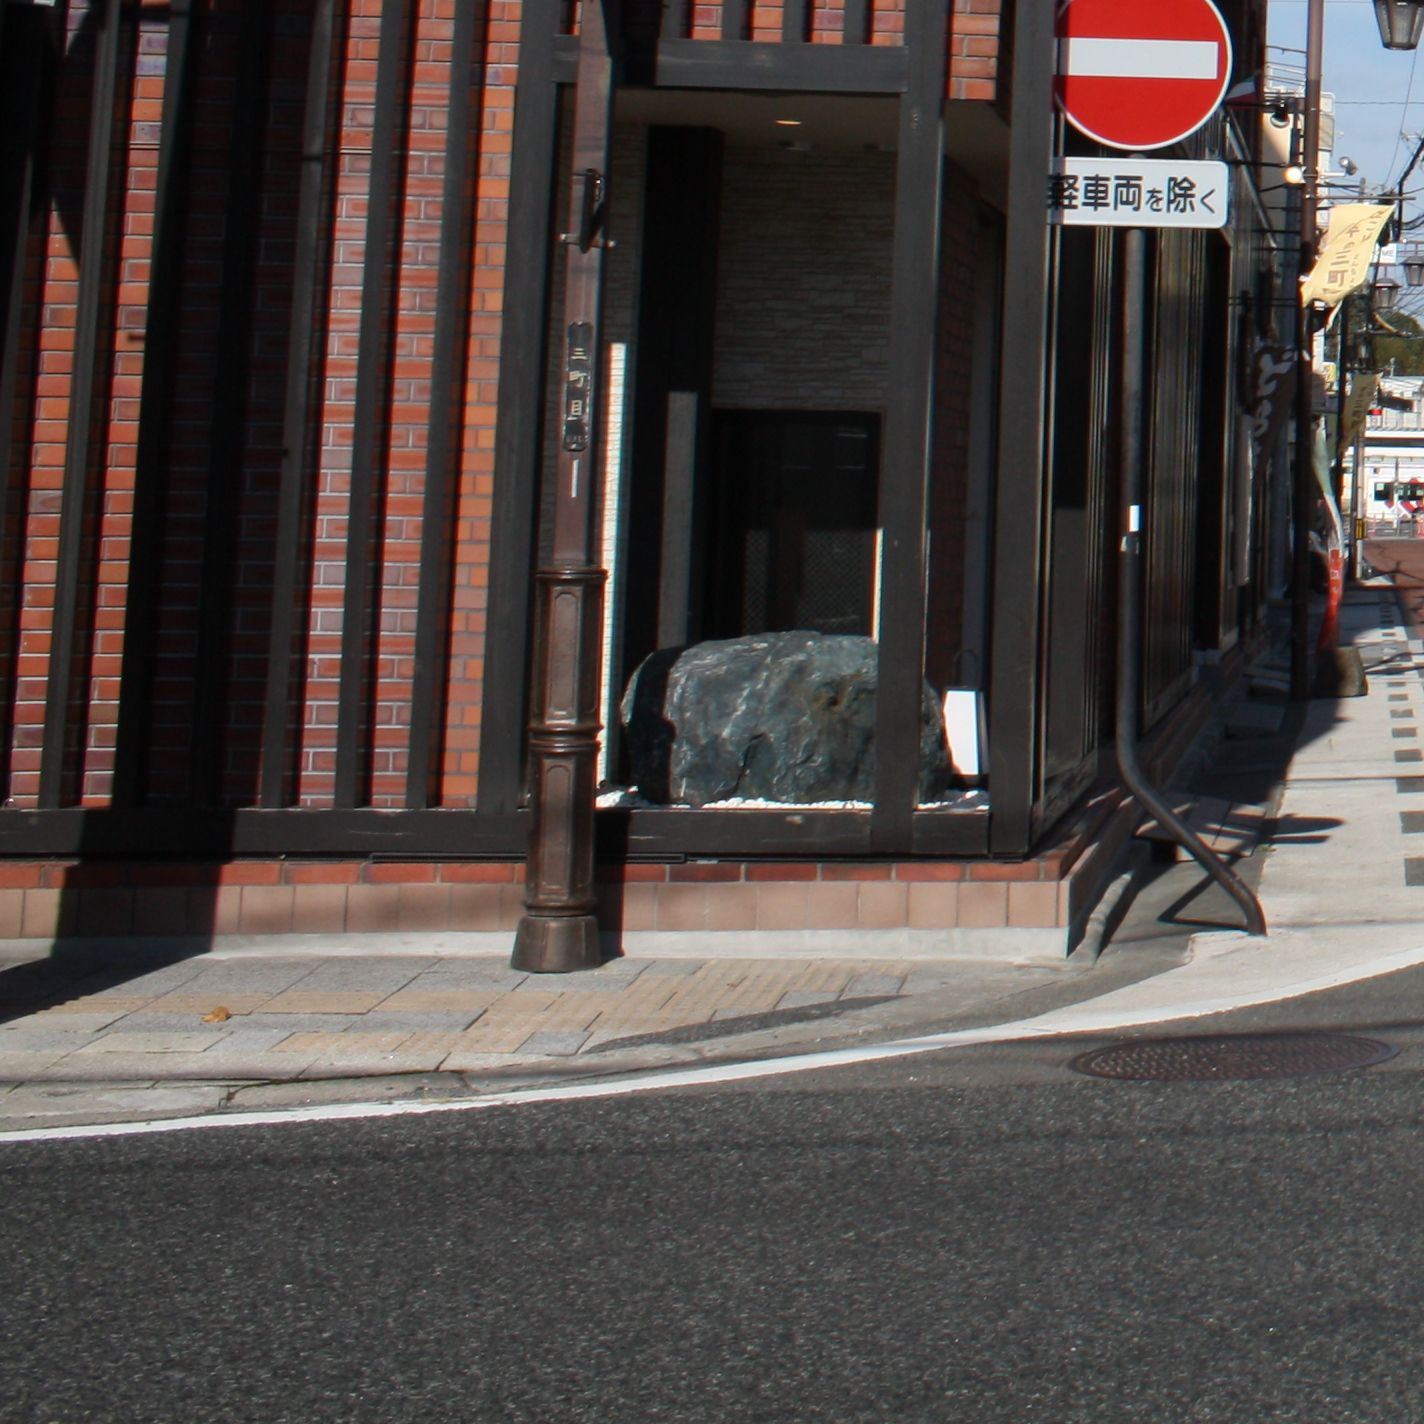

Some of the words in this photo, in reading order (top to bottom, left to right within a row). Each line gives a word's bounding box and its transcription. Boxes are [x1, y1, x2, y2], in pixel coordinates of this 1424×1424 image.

[1047, 173, 1216, 214] 軽車両を除く
[568, 347, 588, 416] 三町目
